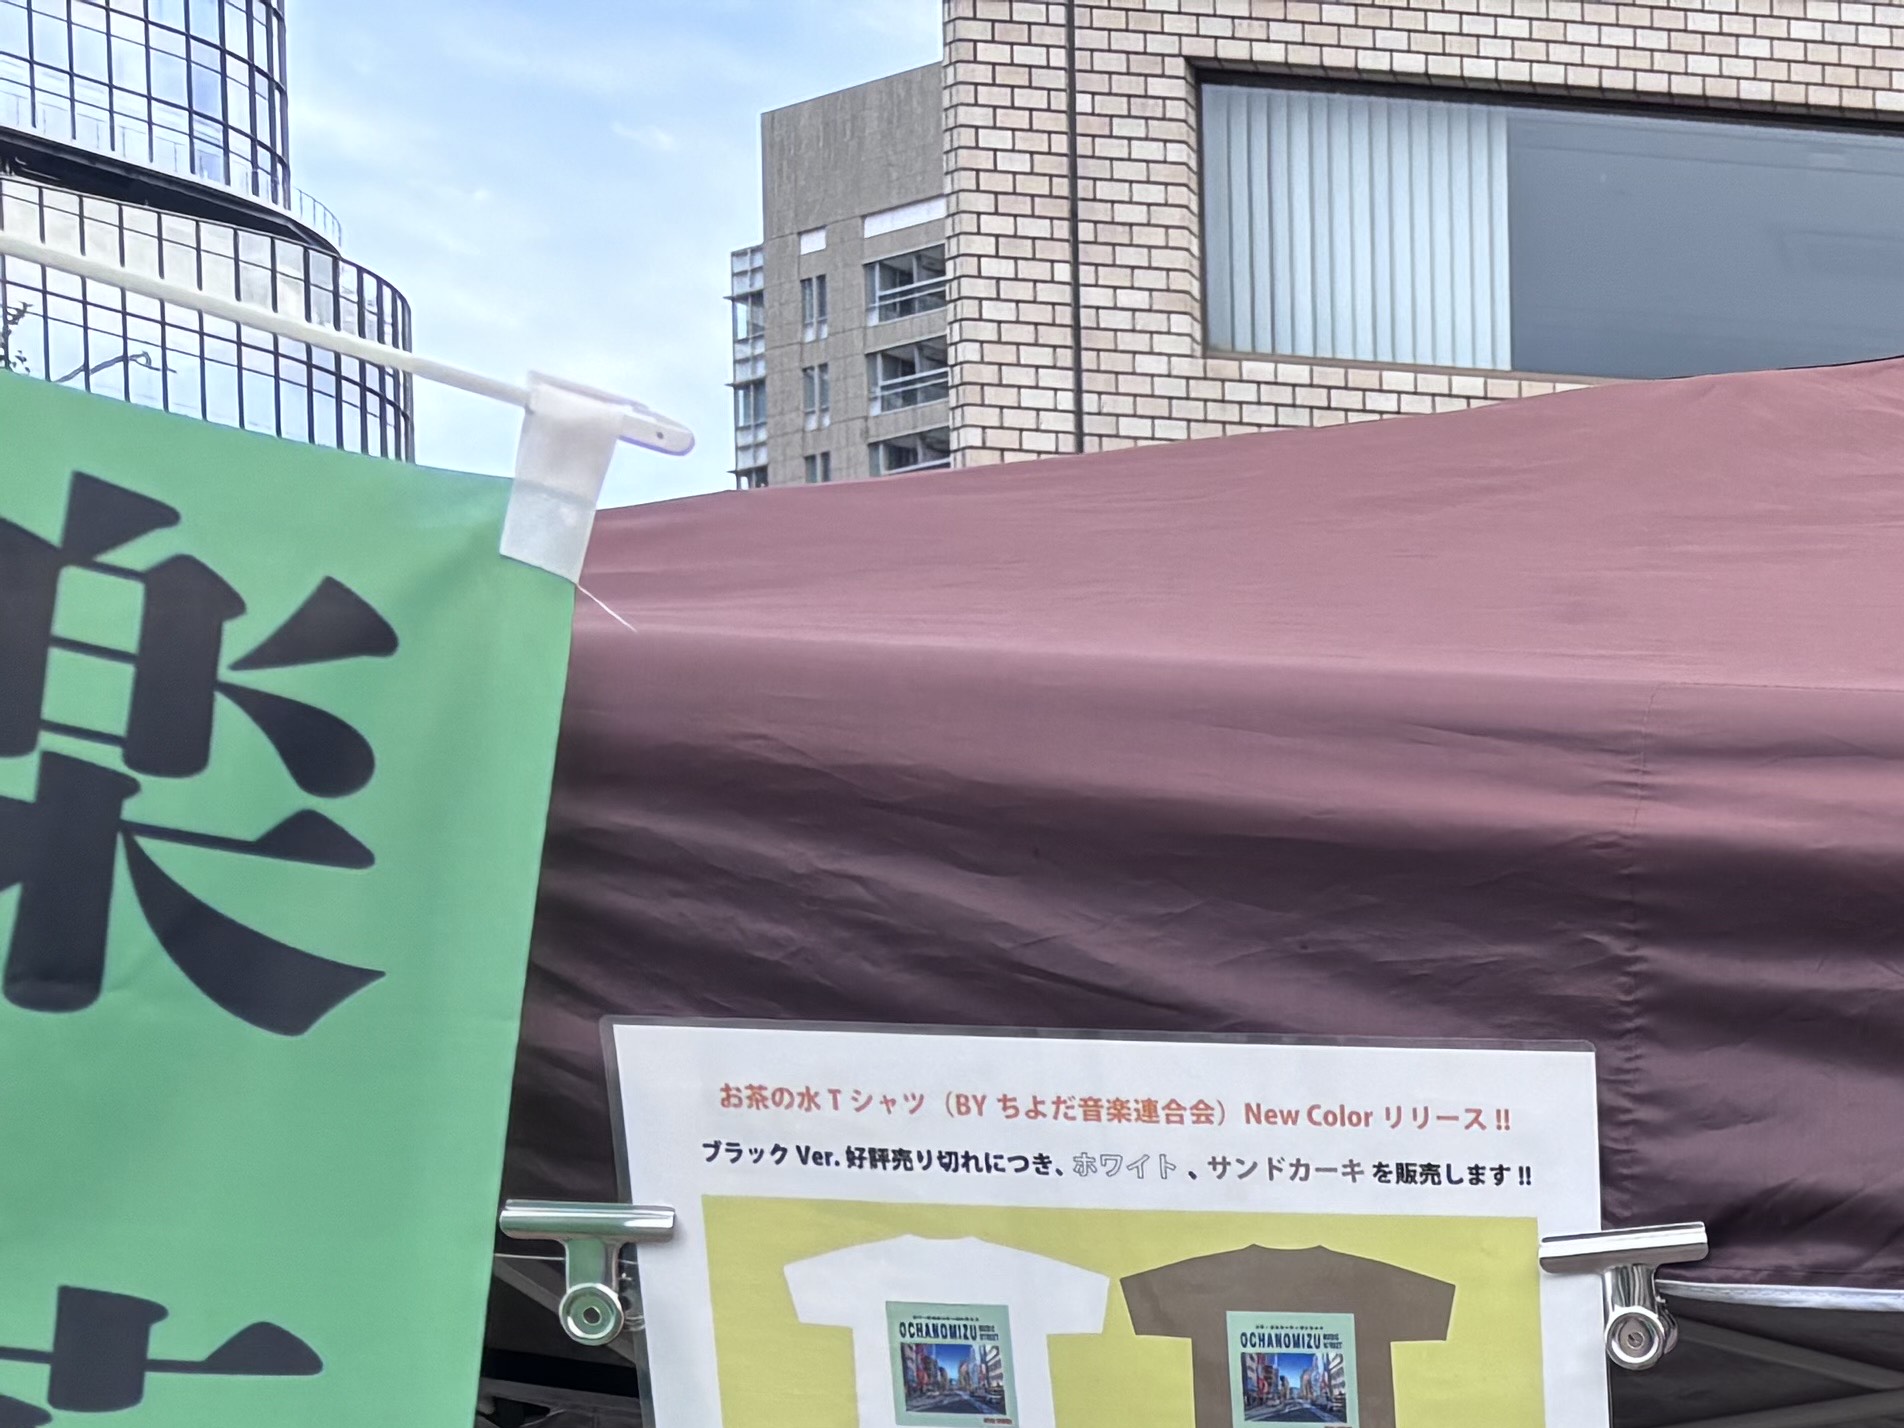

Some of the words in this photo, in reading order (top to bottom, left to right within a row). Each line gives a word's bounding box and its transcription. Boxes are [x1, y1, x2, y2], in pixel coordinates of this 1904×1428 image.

[1245, 1103, 1300, 1126] New
[1307, 1104, 1374, 1128] Color
[797, 1146, 840, 1168] Ver.
[899, 1321, 978, 1341] OCHANOMIZU
[1240, 1331, 1321, 1350] OCHANOMIZU
